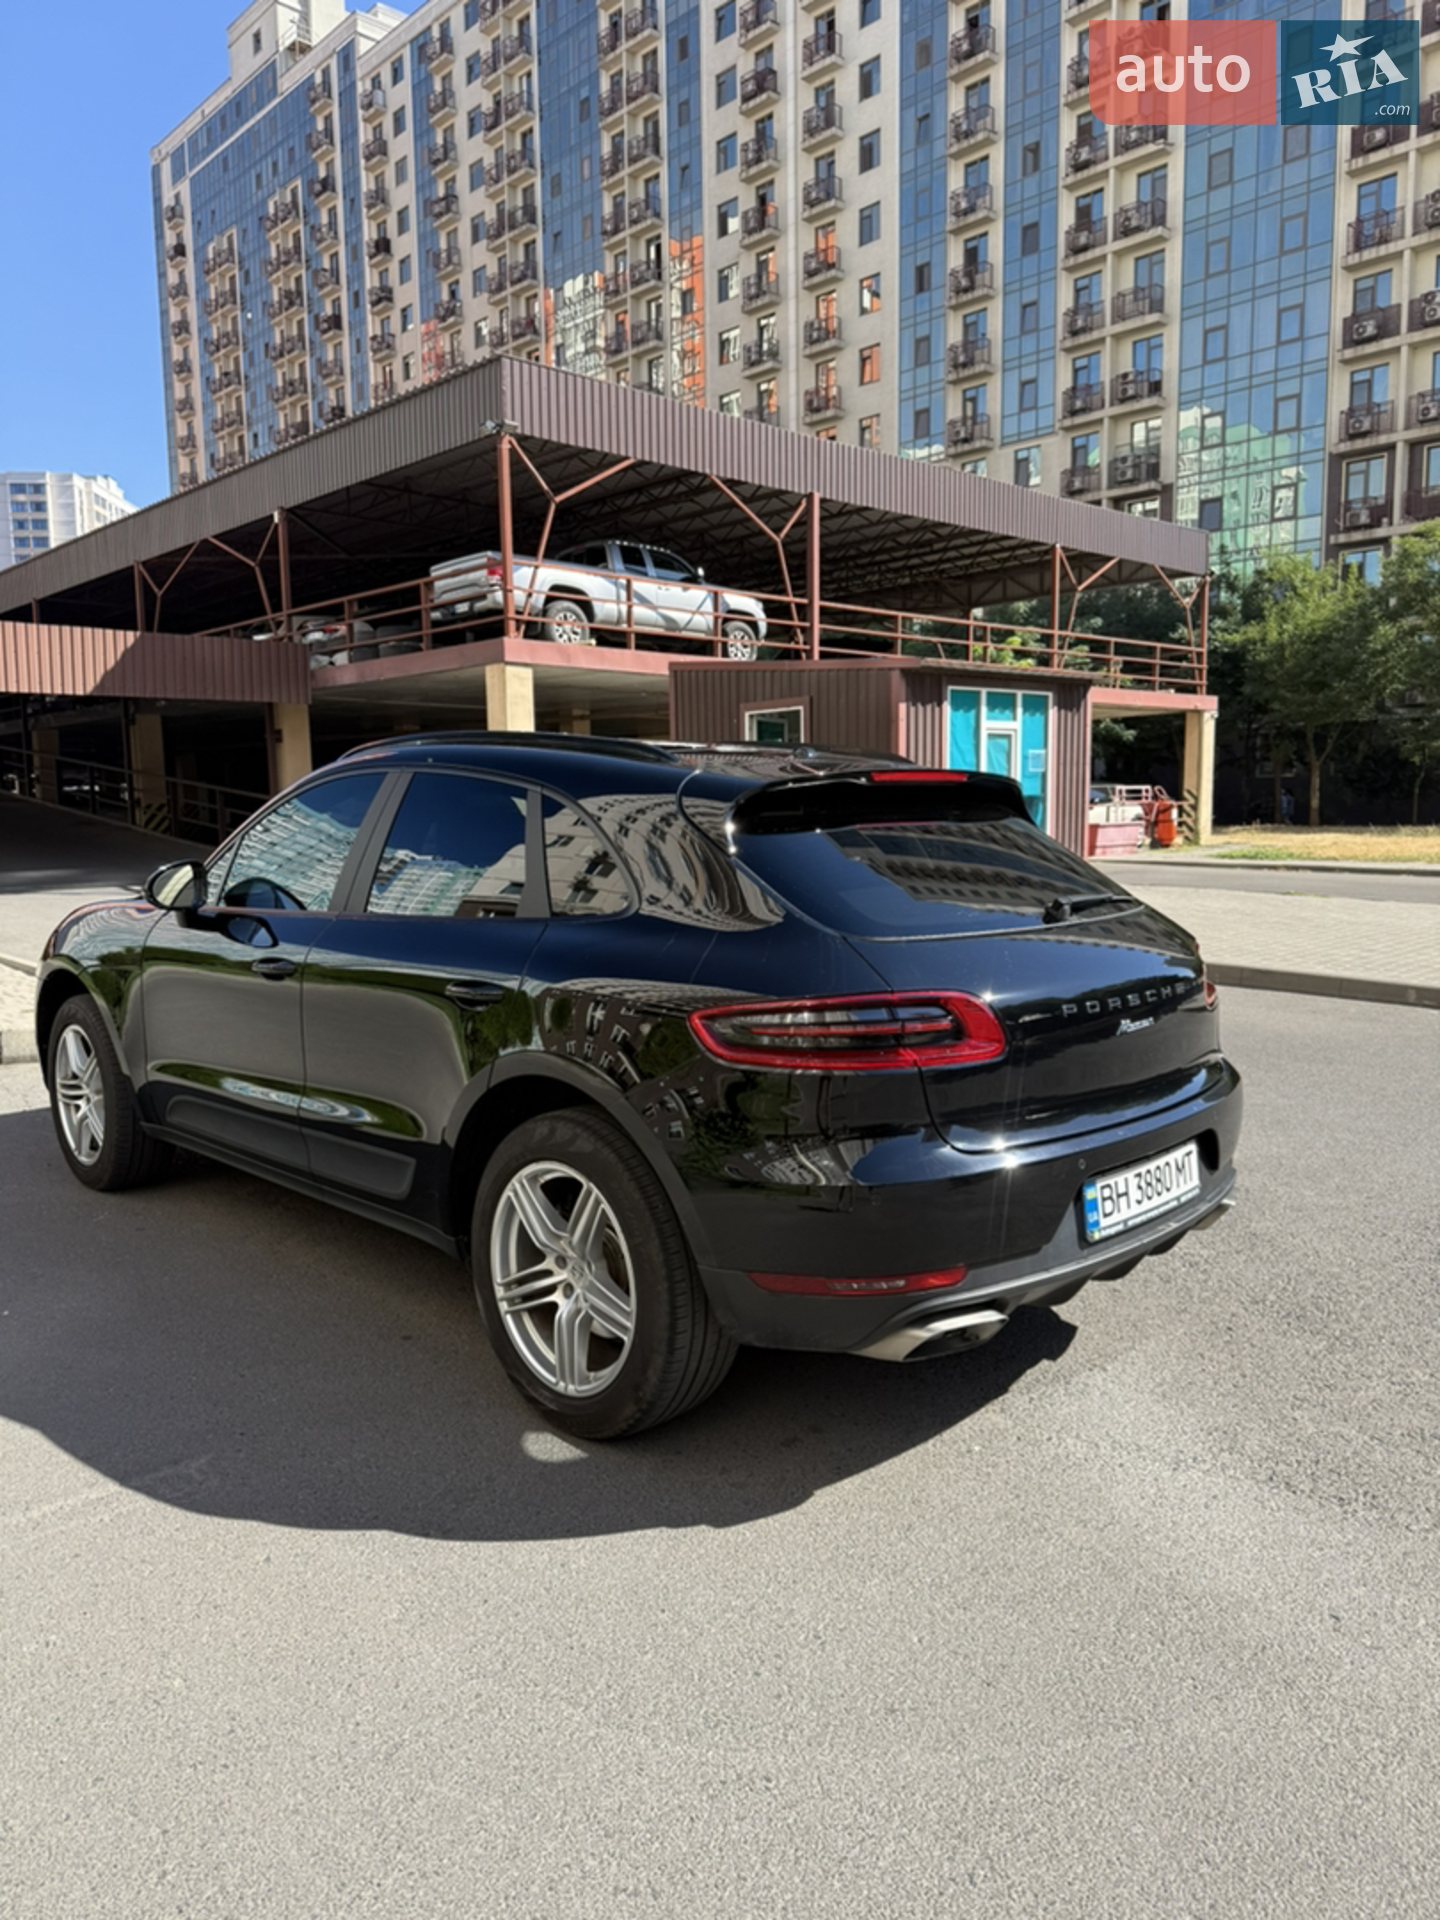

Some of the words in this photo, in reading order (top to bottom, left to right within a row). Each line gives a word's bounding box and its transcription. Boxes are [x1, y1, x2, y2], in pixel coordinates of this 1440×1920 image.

[1062, 984, 1185, 1017] PORSCHE
[1100, 1177, 1131, 1219] BH
[1134, 1161, 1173, 1206] 3880
[1174, 1150, 1193, 1189] MT
